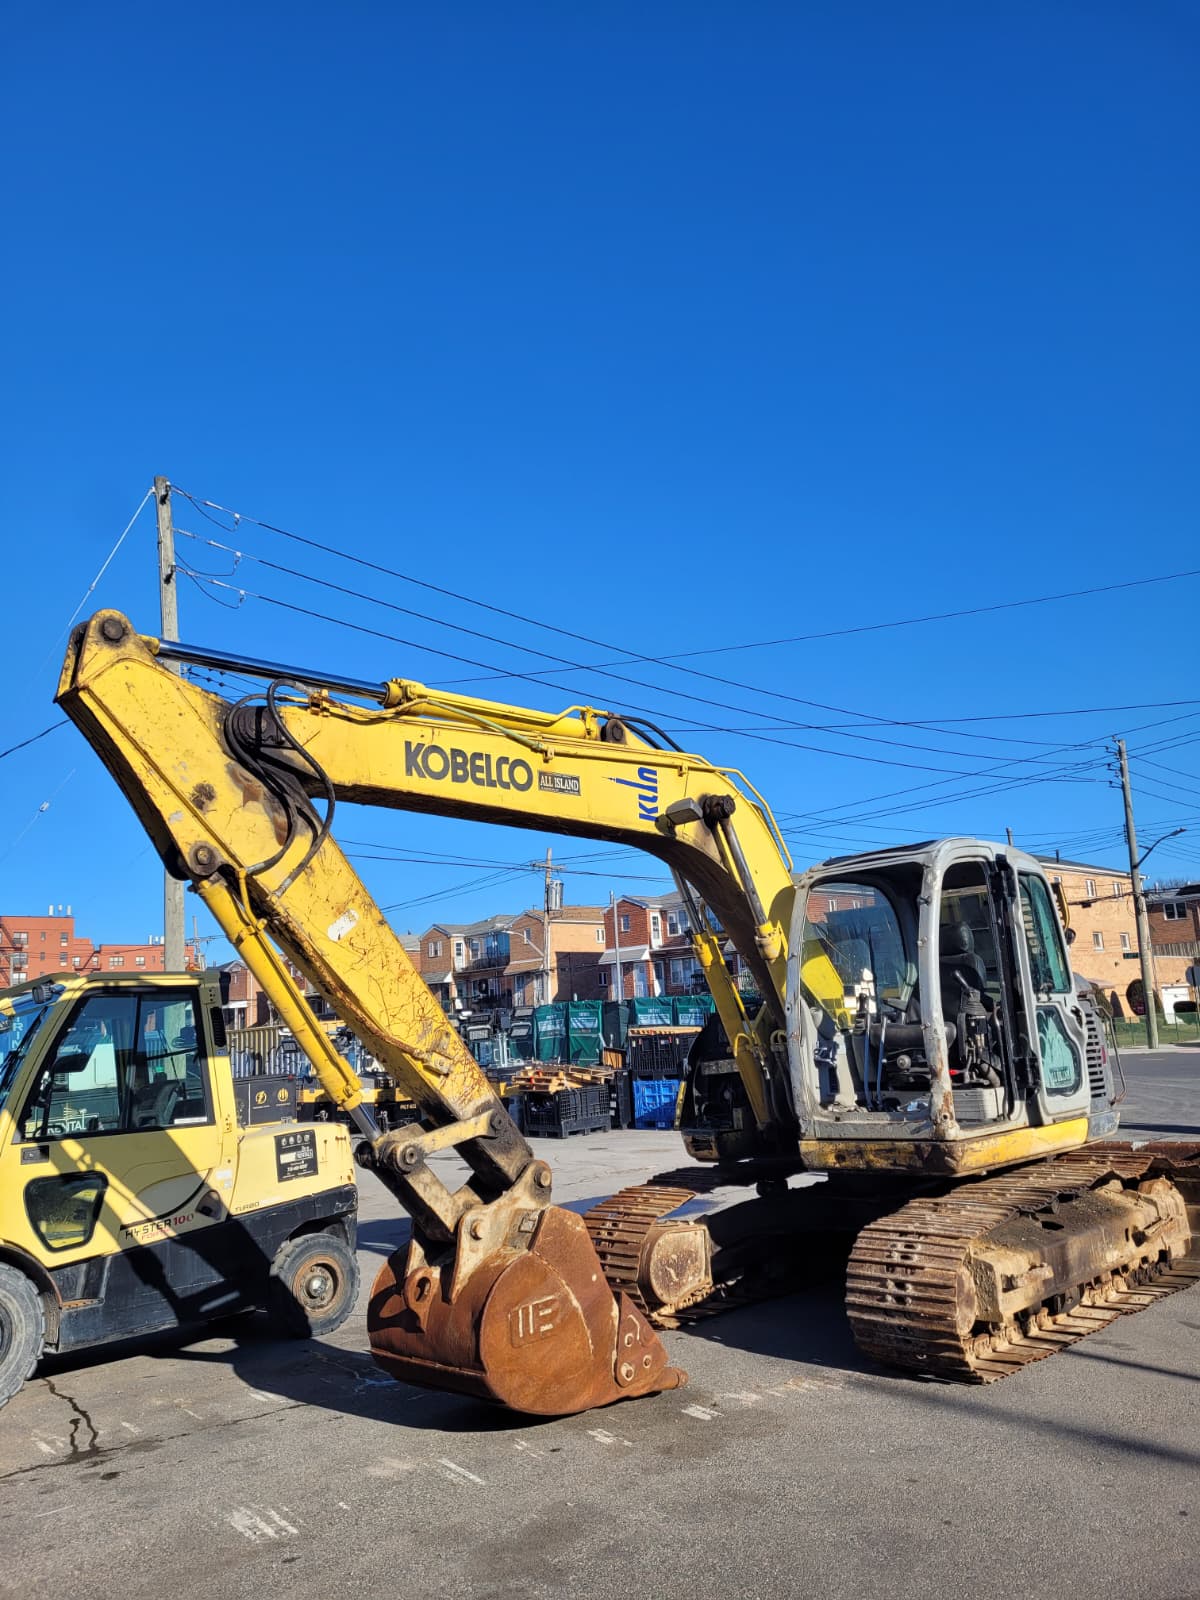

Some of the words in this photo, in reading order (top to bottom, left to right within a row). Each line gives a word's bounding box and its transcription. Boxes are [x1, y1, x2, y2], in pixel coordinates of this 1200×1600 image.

[404, 740, 533, 791] KOBELCO
[540, 775, 554, 788] ALL
[554, 777, 579, 792] ISLAND
[125, 1219, 172, 1240] HYSTER
[173, 1213, 194, 1226] 100
